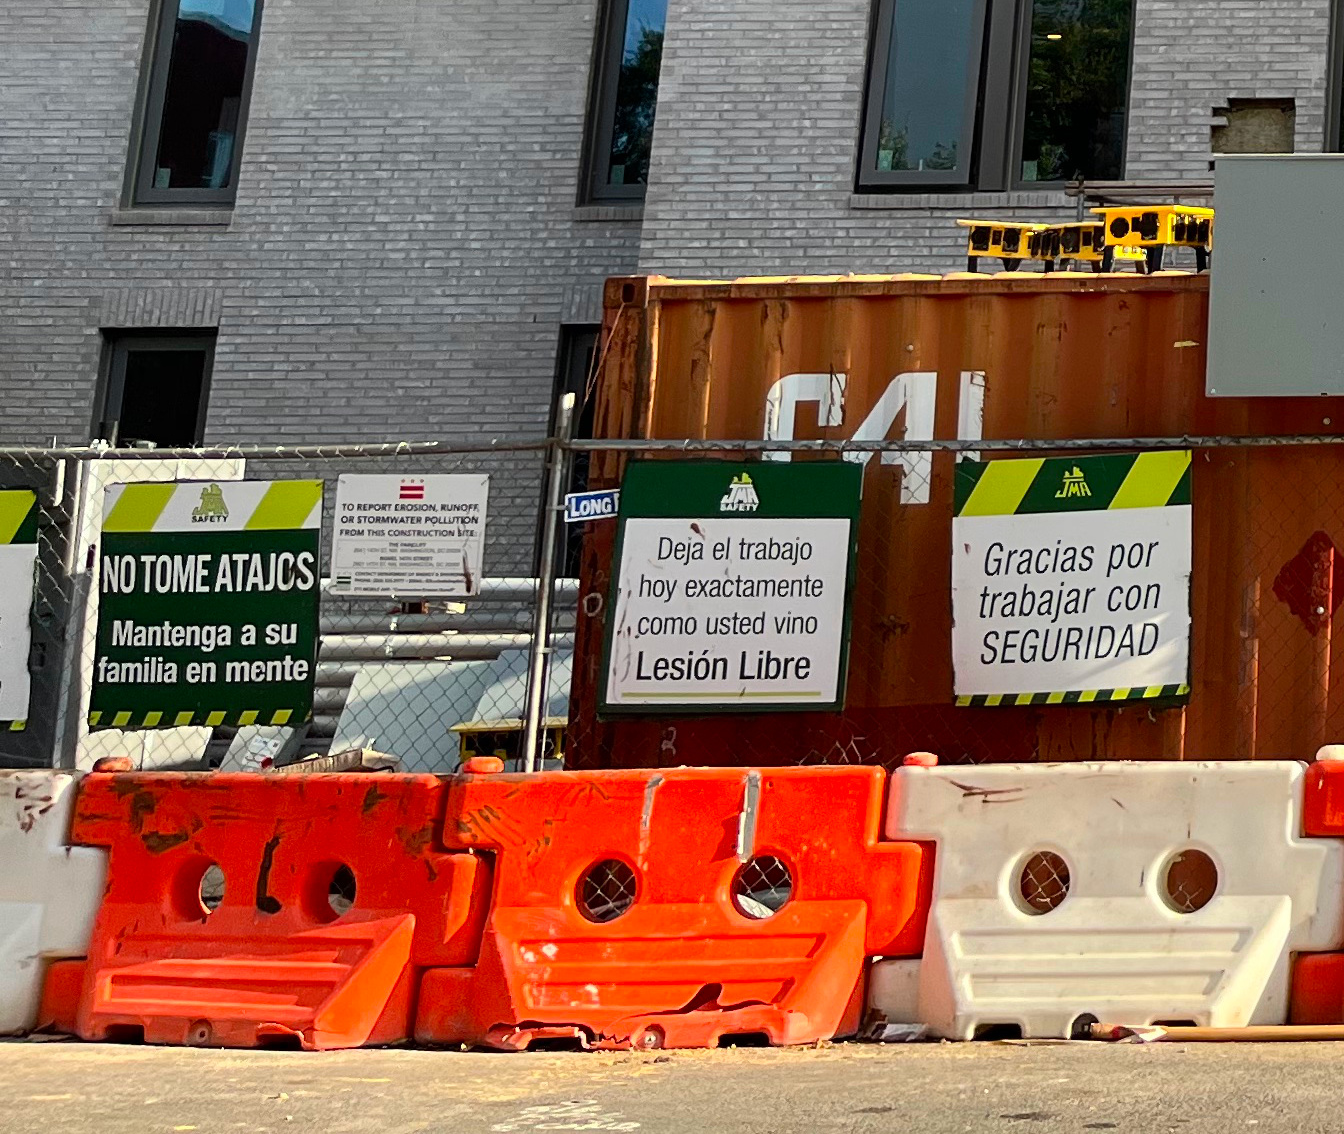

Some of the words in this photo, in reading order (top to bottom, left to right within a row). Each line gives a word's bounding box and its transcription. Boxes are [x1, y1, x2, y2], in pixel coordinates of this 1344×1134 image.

[191, 515, 229, 524] SAFETY
[341, 516, 355, 524] OR
[357, 516, 422, 524] STORMWATER
[424, 515, 479, 525] POLLUTION
[342, 503, 355, 512] TO
[357, 503, 392, 512] REPORT
[394, 503, 438, 513] EROSION,
[569, 498, 612, 517] LONG
[339, 529, 365, 537] FROM
[367, 529, 385, 537] THIS
[388, 529, 455, 537] CONSTRUCTION
[657, 536, 704, 565] Deja
[712, 537, 731, 560] el
[739, 536, 812, 565] trabajo
[984, 539, 1095, 576] Gracias
[1106, 540, 1159, 577] por
[102, 554, 136, 593] NO
[140, 554, 212, 593] TOME
[214, 551, 315, 593] ATAJOS
[638, 574, 677, 603] hoy
[685, 576, 823, 598] exactamente
[979, 581, 1096, 624] trabajar
[1107, 581, 1161, 612] con
[111, 619, 232, 652] Mantenga
[240, 624, 257, 646] a
[265, 623, 298, 646] su
[637, 615, 697, 636] como
[706, 611, 766, 635] usted
[774, 611, 818, 635] vino
[980, 622, 1160, 665] SEGURIDAD
[98, 656, 178, 683] familia
[185, 661, 216, 683] en
[225, 655, 309, 683] mente
[636, 649, 728, 681] Lesión
[739, 650, 812, 681] Libre
